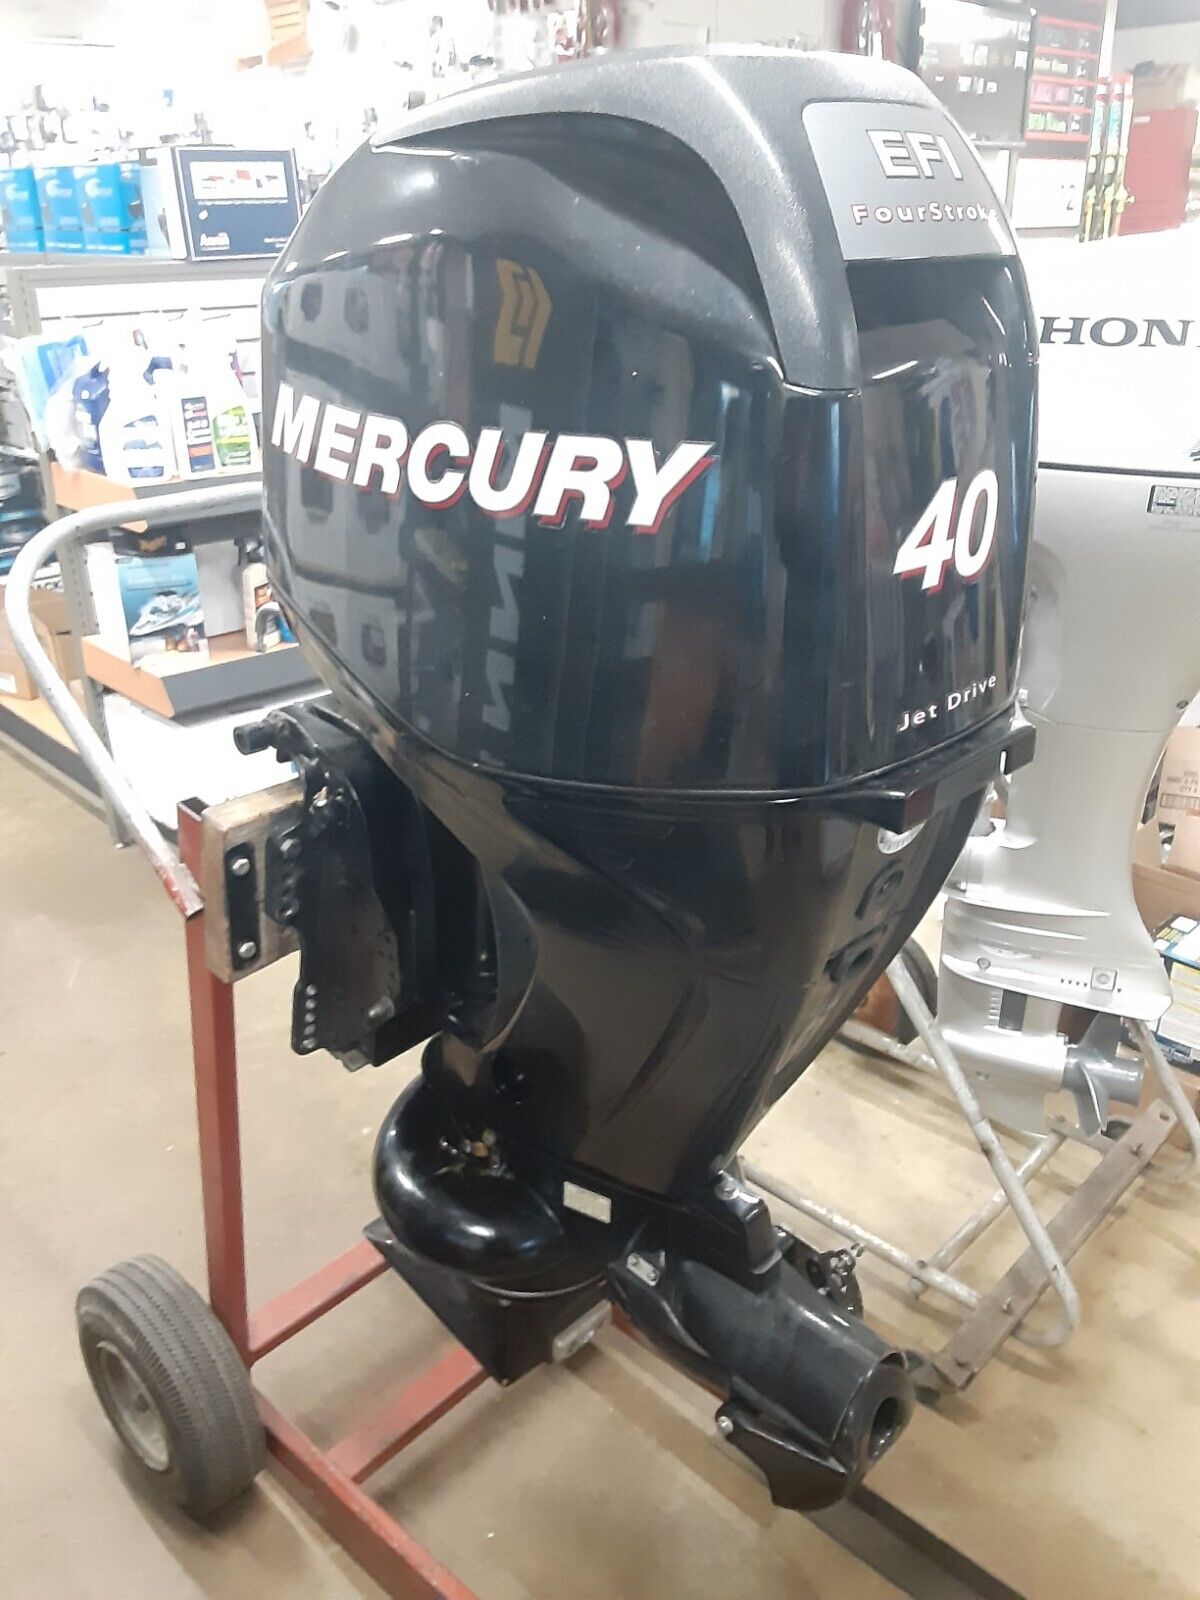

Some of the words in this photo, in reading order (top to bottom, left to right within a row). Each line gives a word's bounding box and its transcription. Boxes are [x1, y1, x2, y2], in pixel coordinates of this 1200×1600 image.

[866, 129, 964, 181] EFI
[851, 202, 999, 225] FourStroke
[1040, 316, 1200, 348] HON
[271, 382, 716, 533] MERCURY
[893, 469, 999, 595] 40
[897, 704, 938, 733] Jet
[947, 674, 997, 711] Drive
